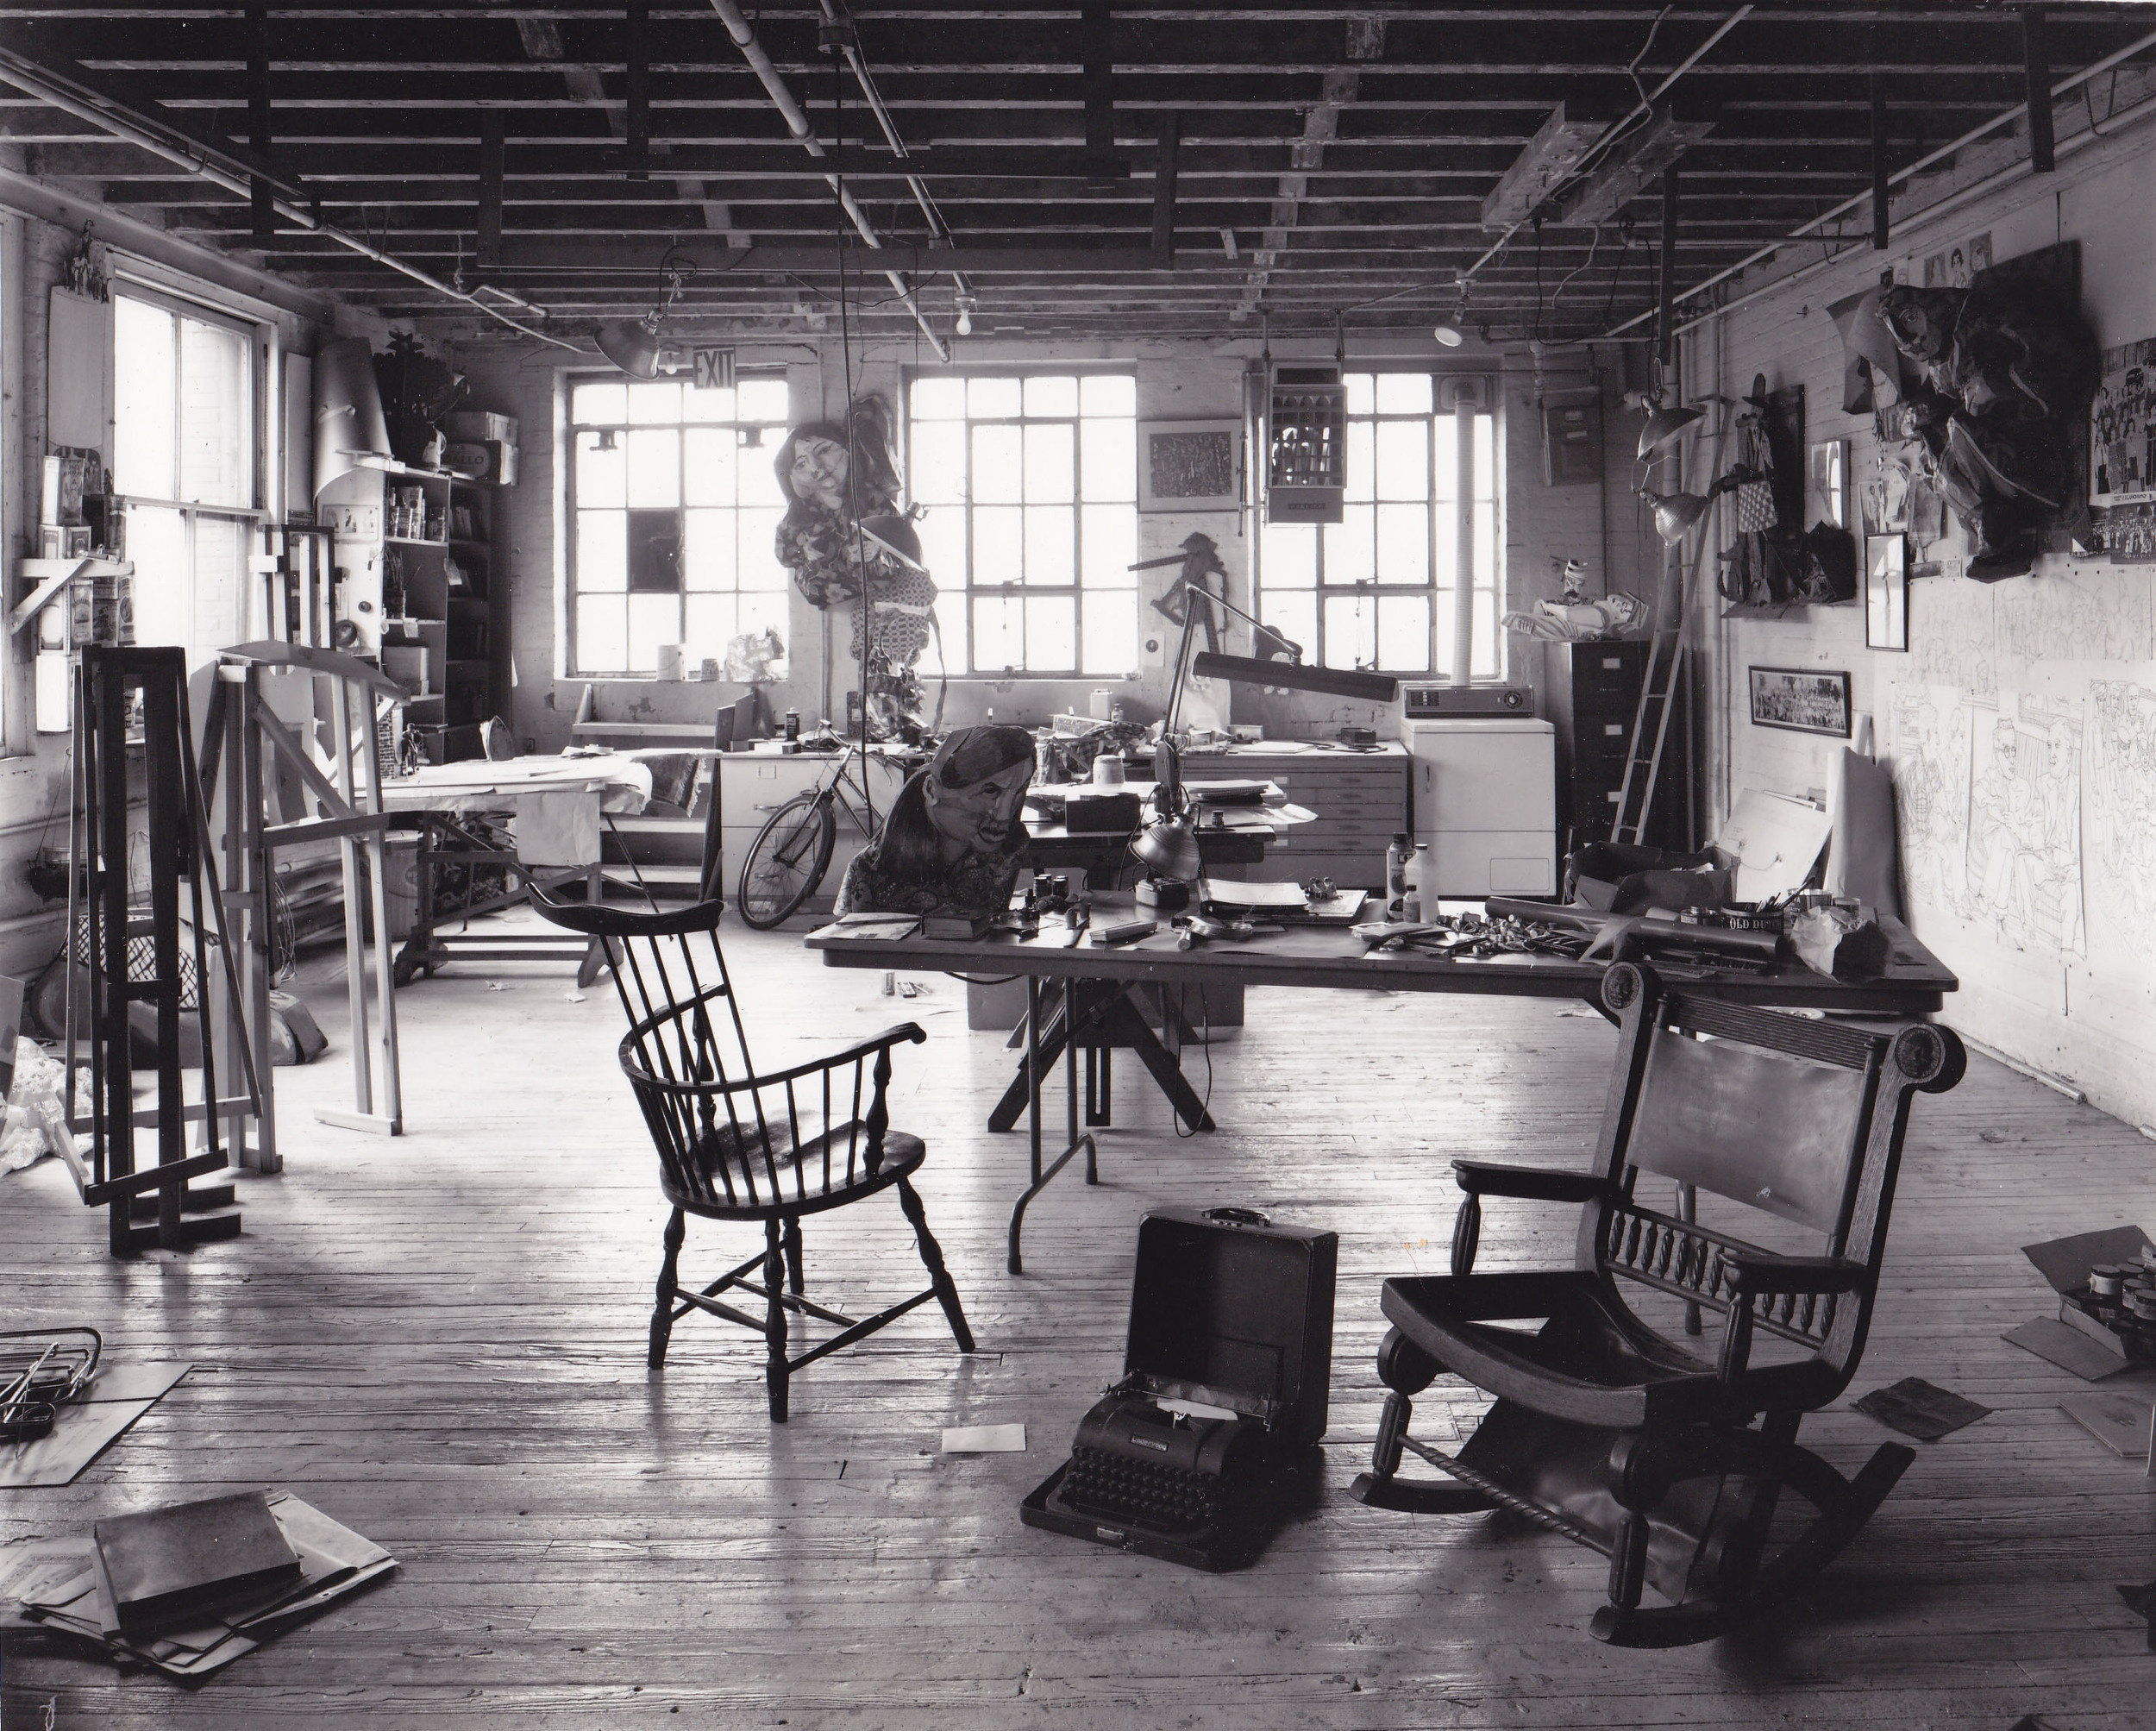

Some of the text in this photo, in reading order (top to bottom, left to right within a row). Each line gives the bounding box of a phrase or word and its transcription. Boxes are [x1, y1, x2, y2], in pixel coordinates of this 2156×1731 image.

[693, 349, 734, 389] EXIT
[1729, 917, 1750, 930] OLD
[1131, 1435, 1167, 1451] Underwood
